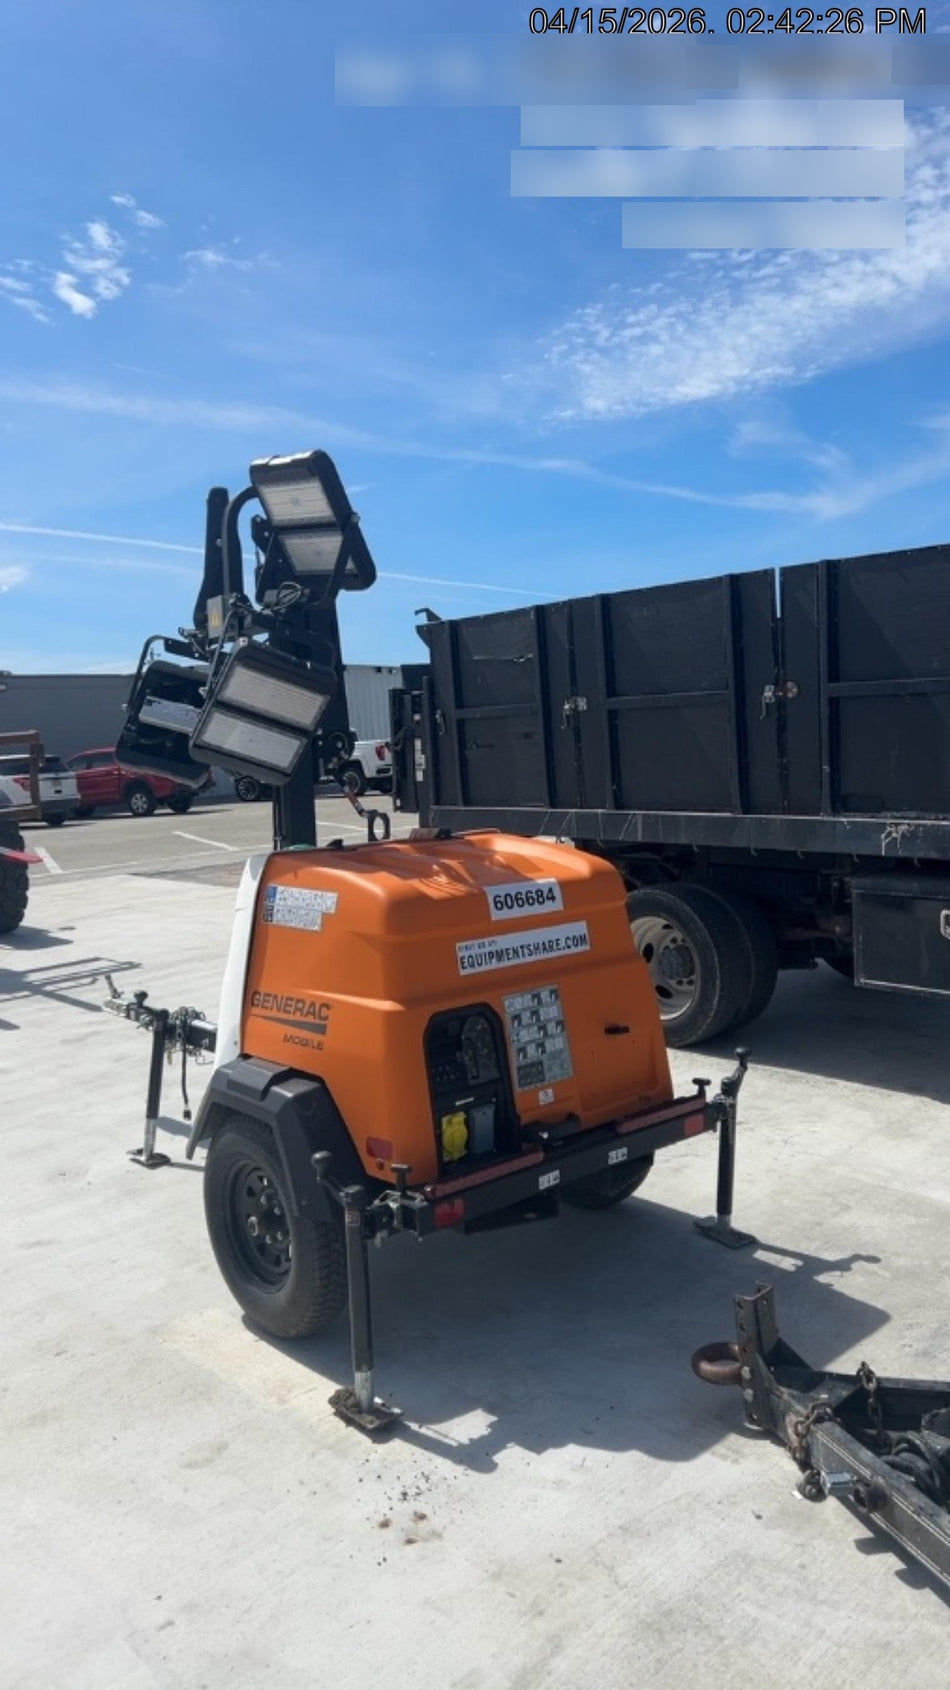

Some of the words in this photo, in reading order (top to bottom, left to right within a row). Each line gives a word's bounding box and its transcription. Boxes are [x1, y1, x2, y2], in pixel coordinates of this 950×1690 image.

[493, 887, 556, 911] 606684
[459, 933, 588, 970] EQUIPMENTSHARE.COM
[251, 990, 331, 1021] GENERAC
[283, 1033, 324, 1050] MOBILE
